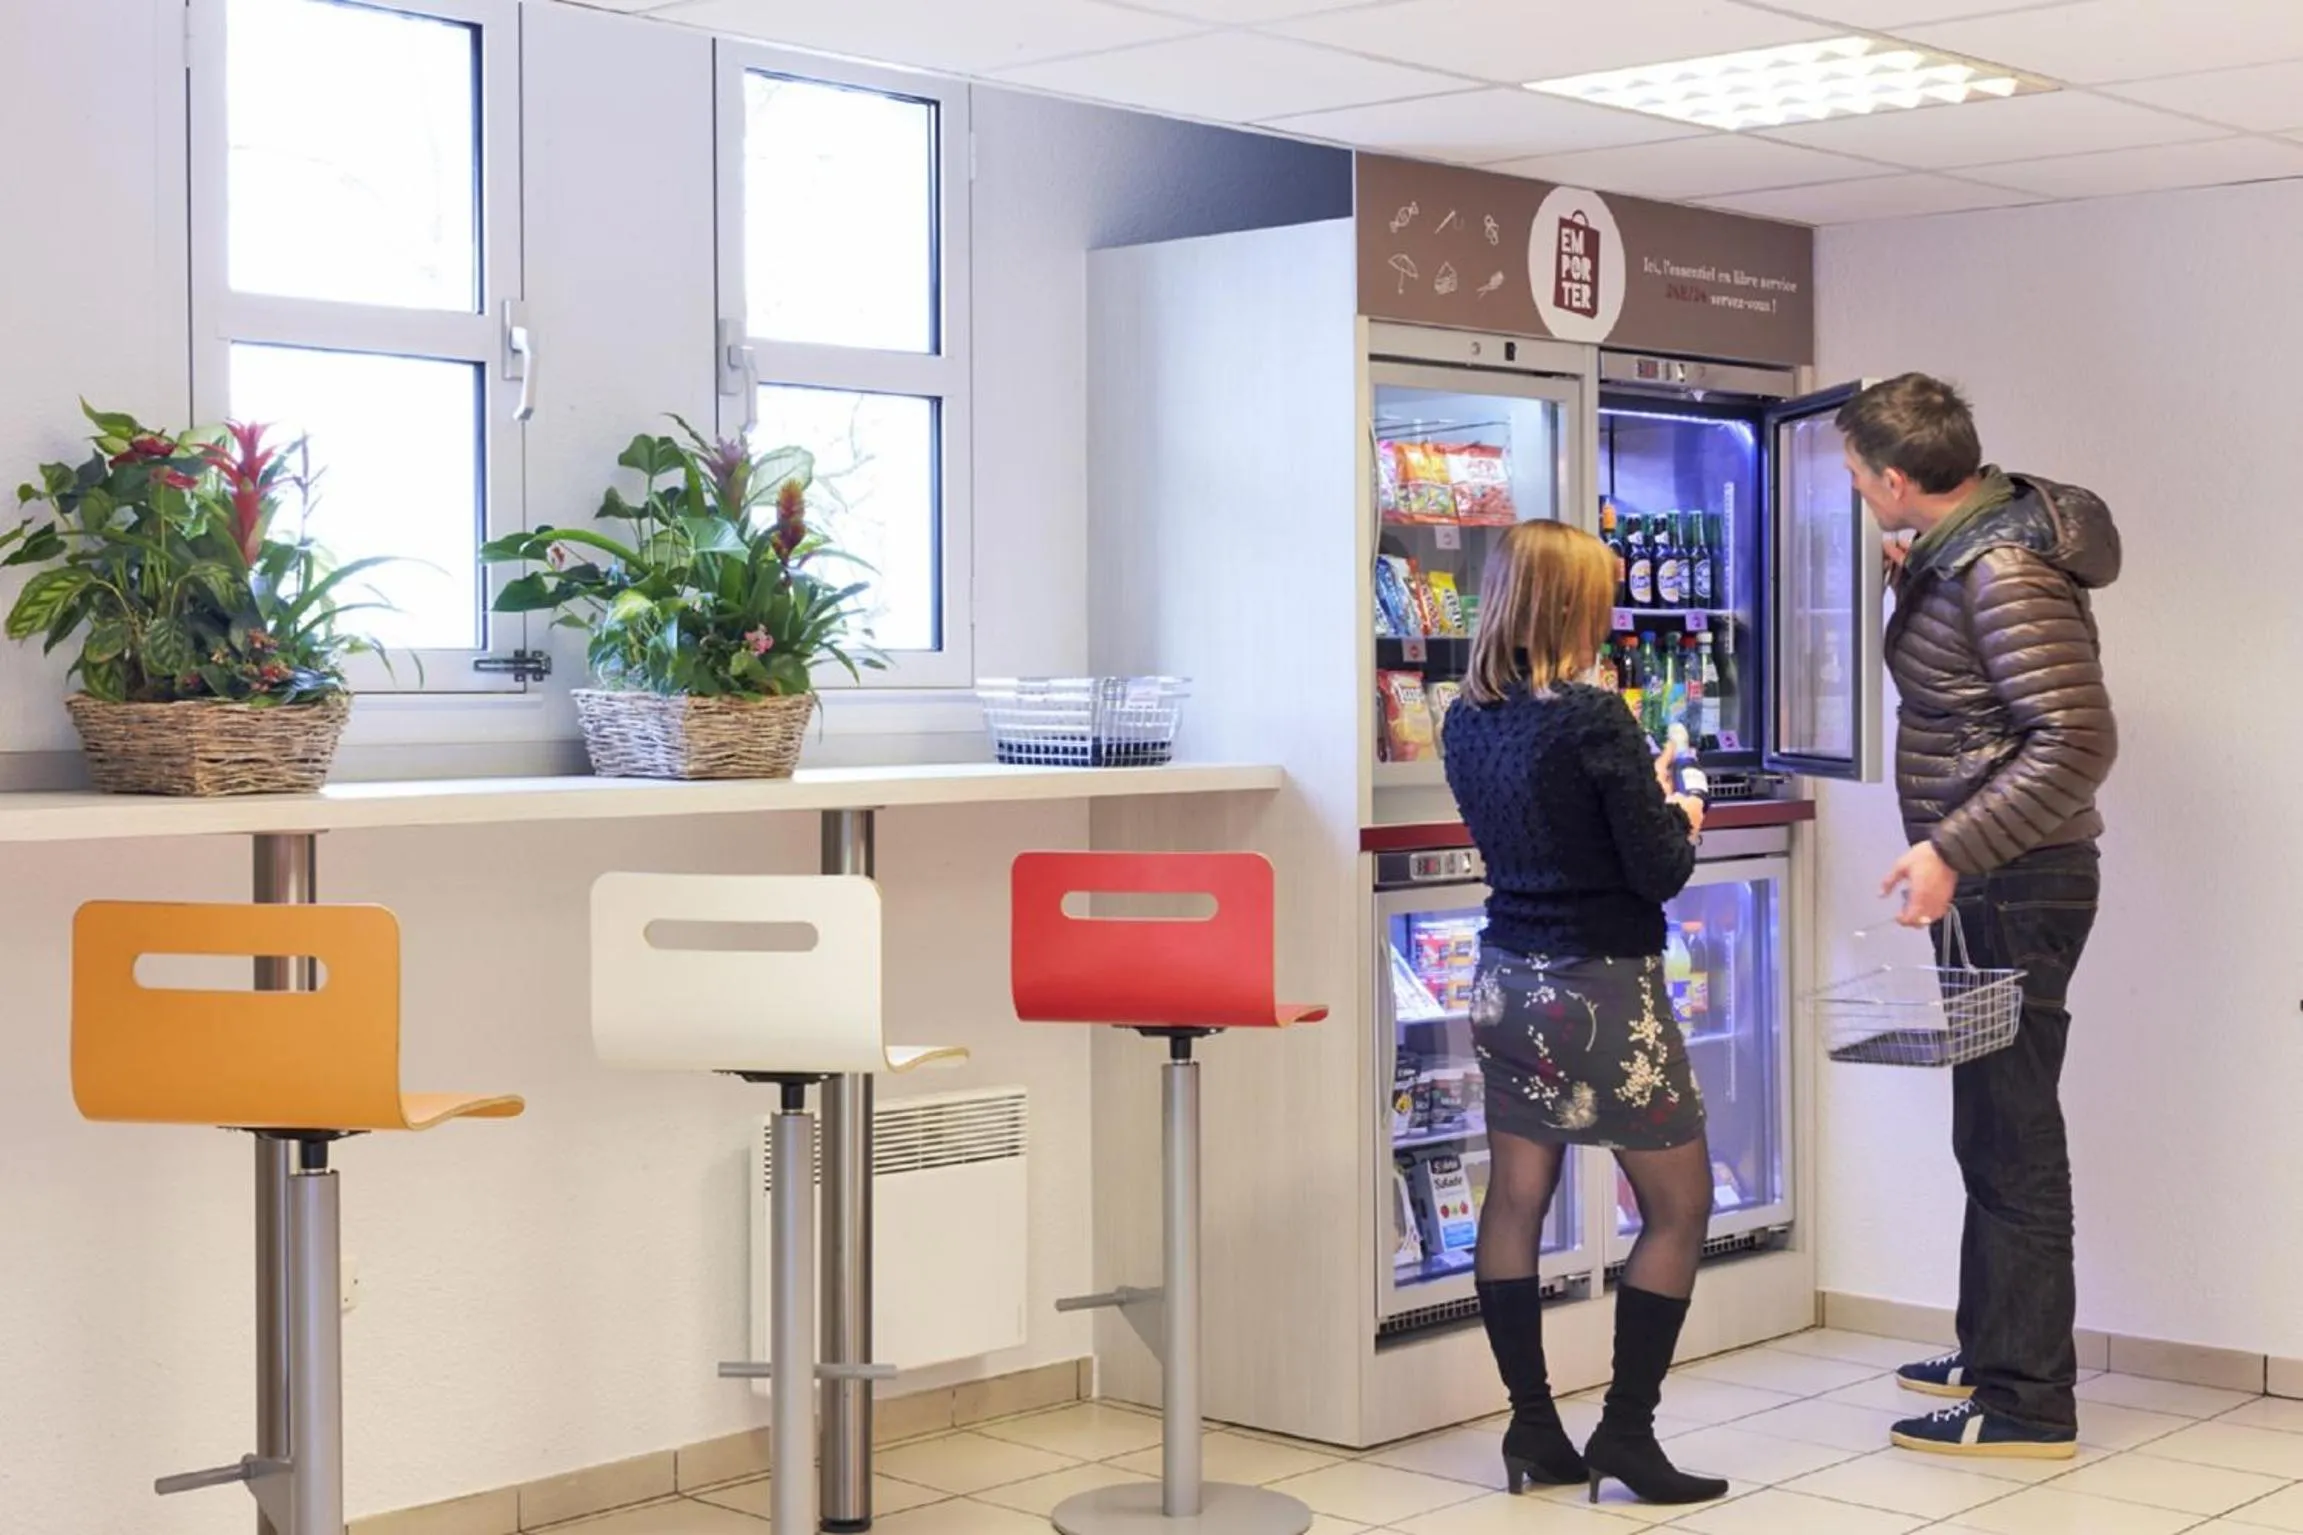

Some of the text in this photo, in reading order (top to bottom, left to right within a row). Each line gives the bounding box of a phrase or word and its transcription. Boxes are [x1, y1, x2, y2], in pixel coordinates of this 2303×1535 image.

[1561, 228, 1584, 254] EM
[1561, 254, 1592, 281] POR
[1717, 272, 1731, 285] en
[1733, 270, 1757, 288] libre
[1760, 275, 1797, 293] service
[1561, 281, 1591, 309] TER
